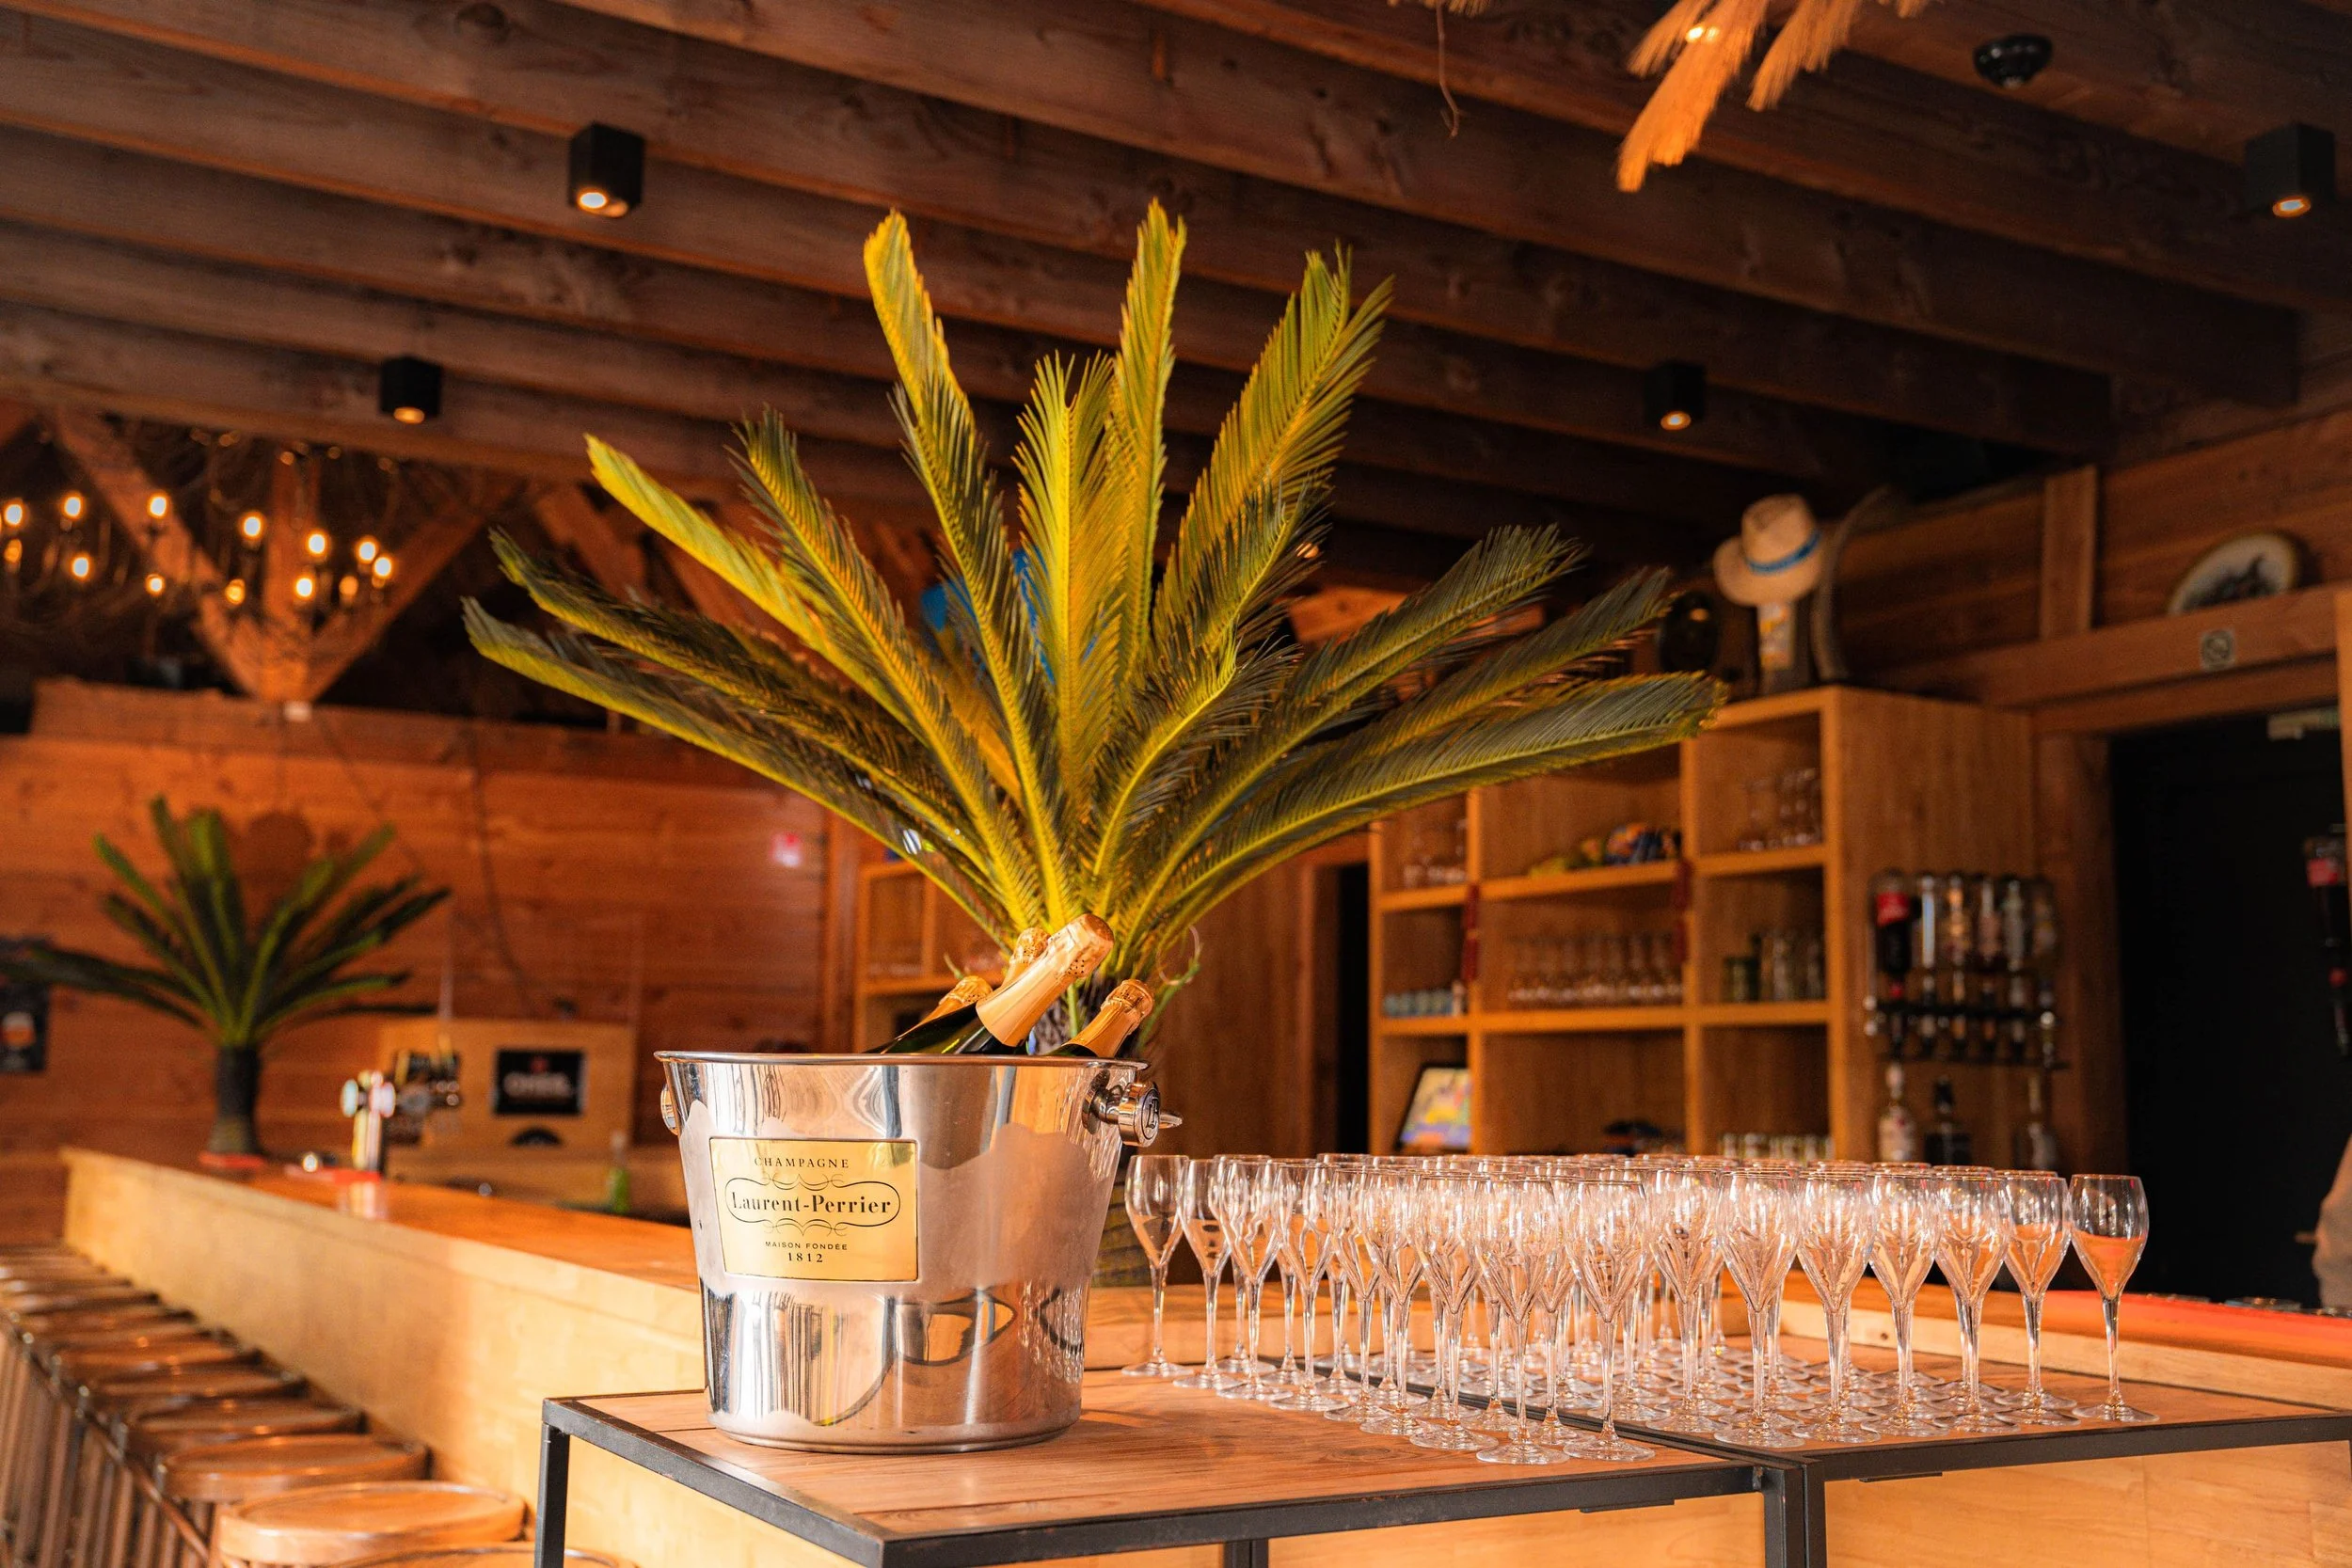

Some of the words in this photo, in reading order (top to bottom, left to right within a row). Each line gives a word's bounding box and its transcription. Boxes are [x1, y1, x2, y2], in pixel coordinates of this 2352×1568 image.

[754, 1157, 850, 1168] CHAMPAGNE
[731, 1191, 892, 1214] Laurent-Perrier
[765, 1241, 802, 1249] MAISON
[788, 1252, 823, 1263] 1812
